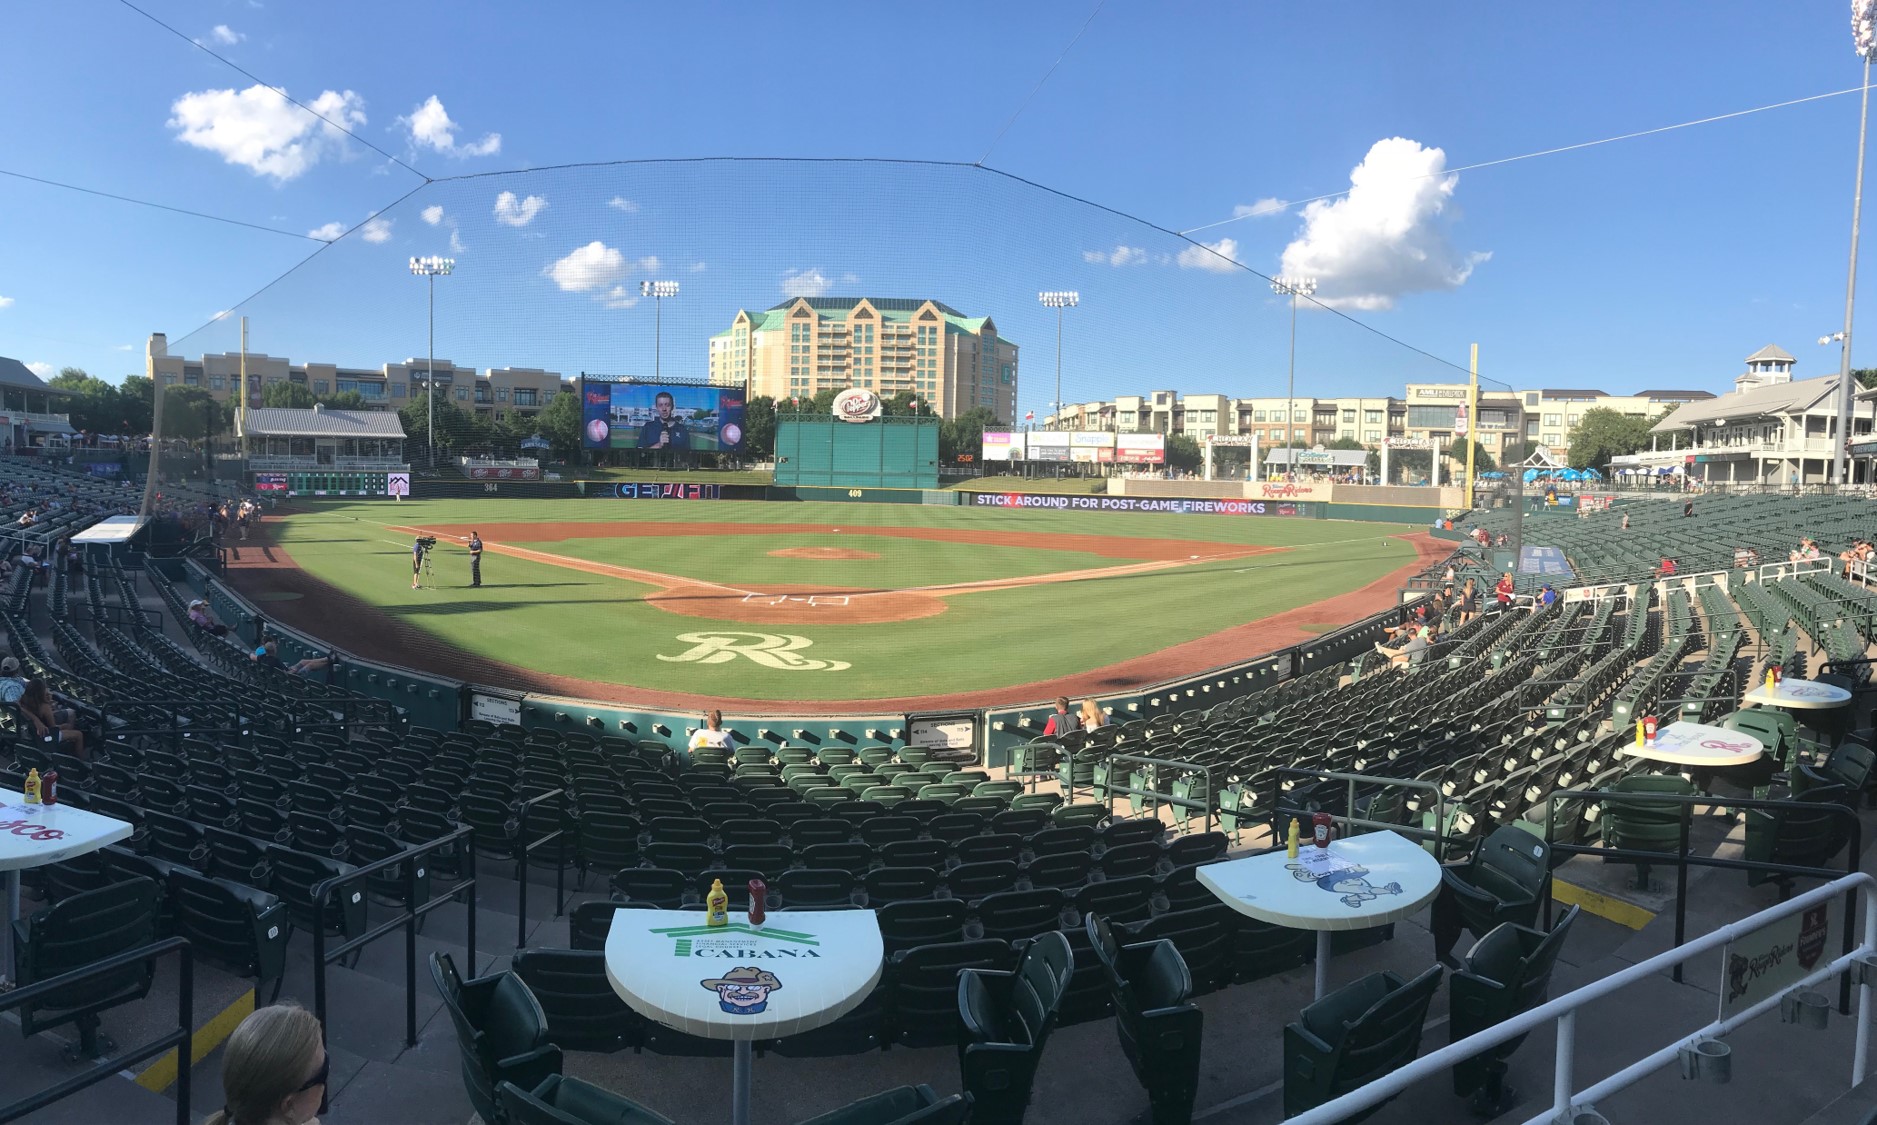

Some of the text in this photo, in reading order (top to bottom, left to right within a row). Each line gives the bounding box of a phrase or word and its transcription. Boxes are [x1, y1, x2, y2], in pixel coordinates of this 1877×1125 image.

[1075, 433, 1109, 445] Snapple
[484, 483, 498, 492] 364
[1262, 483, 1313, 498] RoughRiders
[848, 489, 862, 498] 409
[977, 494, 1012, 505] STICK
[1015, 496, 1068, 507] AROUND
[1072, 497, 1098, 509] FOR
[1101, 499, 1179, 511] POST-GAME
[1183, 501, 1266, 514] FIREWORKS
[486, 698, 508, 706] SECTIONS
[694, 949, 821, 959] CABANA
